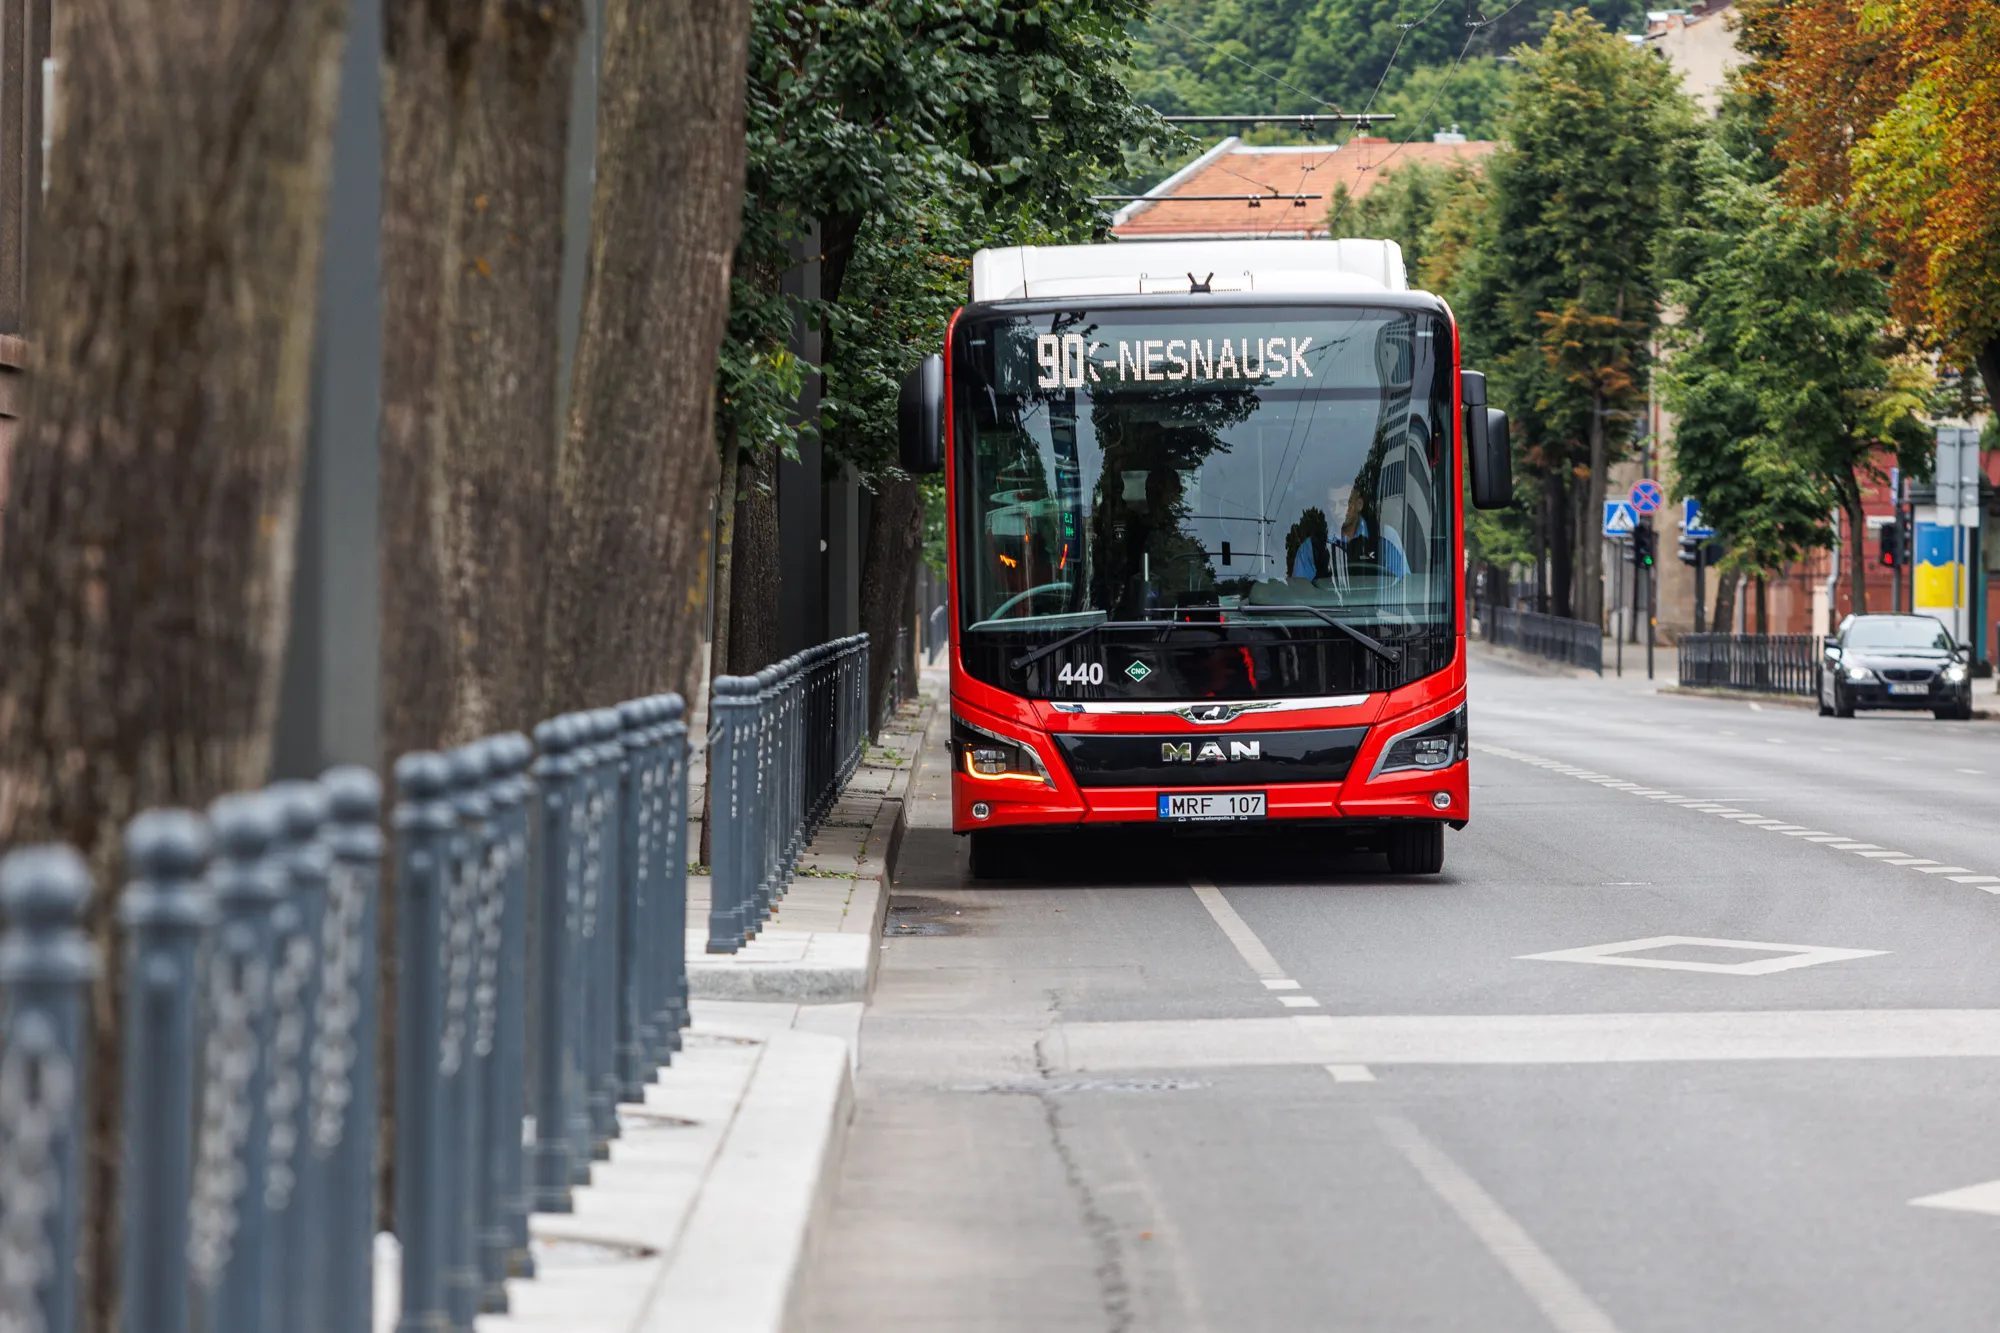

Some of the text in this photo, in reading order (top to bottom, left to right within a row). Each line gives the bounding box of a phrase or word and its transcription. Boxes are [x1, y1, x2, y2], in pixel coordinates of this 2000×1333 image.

[1037, 333, 1085, 388] 90
[1058, 662, 1104, 686] 440
[1130, 667, 1146, 675] CNG
[1161, 741, 1261, 762] MAN
[1172, 797, 1261, 814] MRF 107
